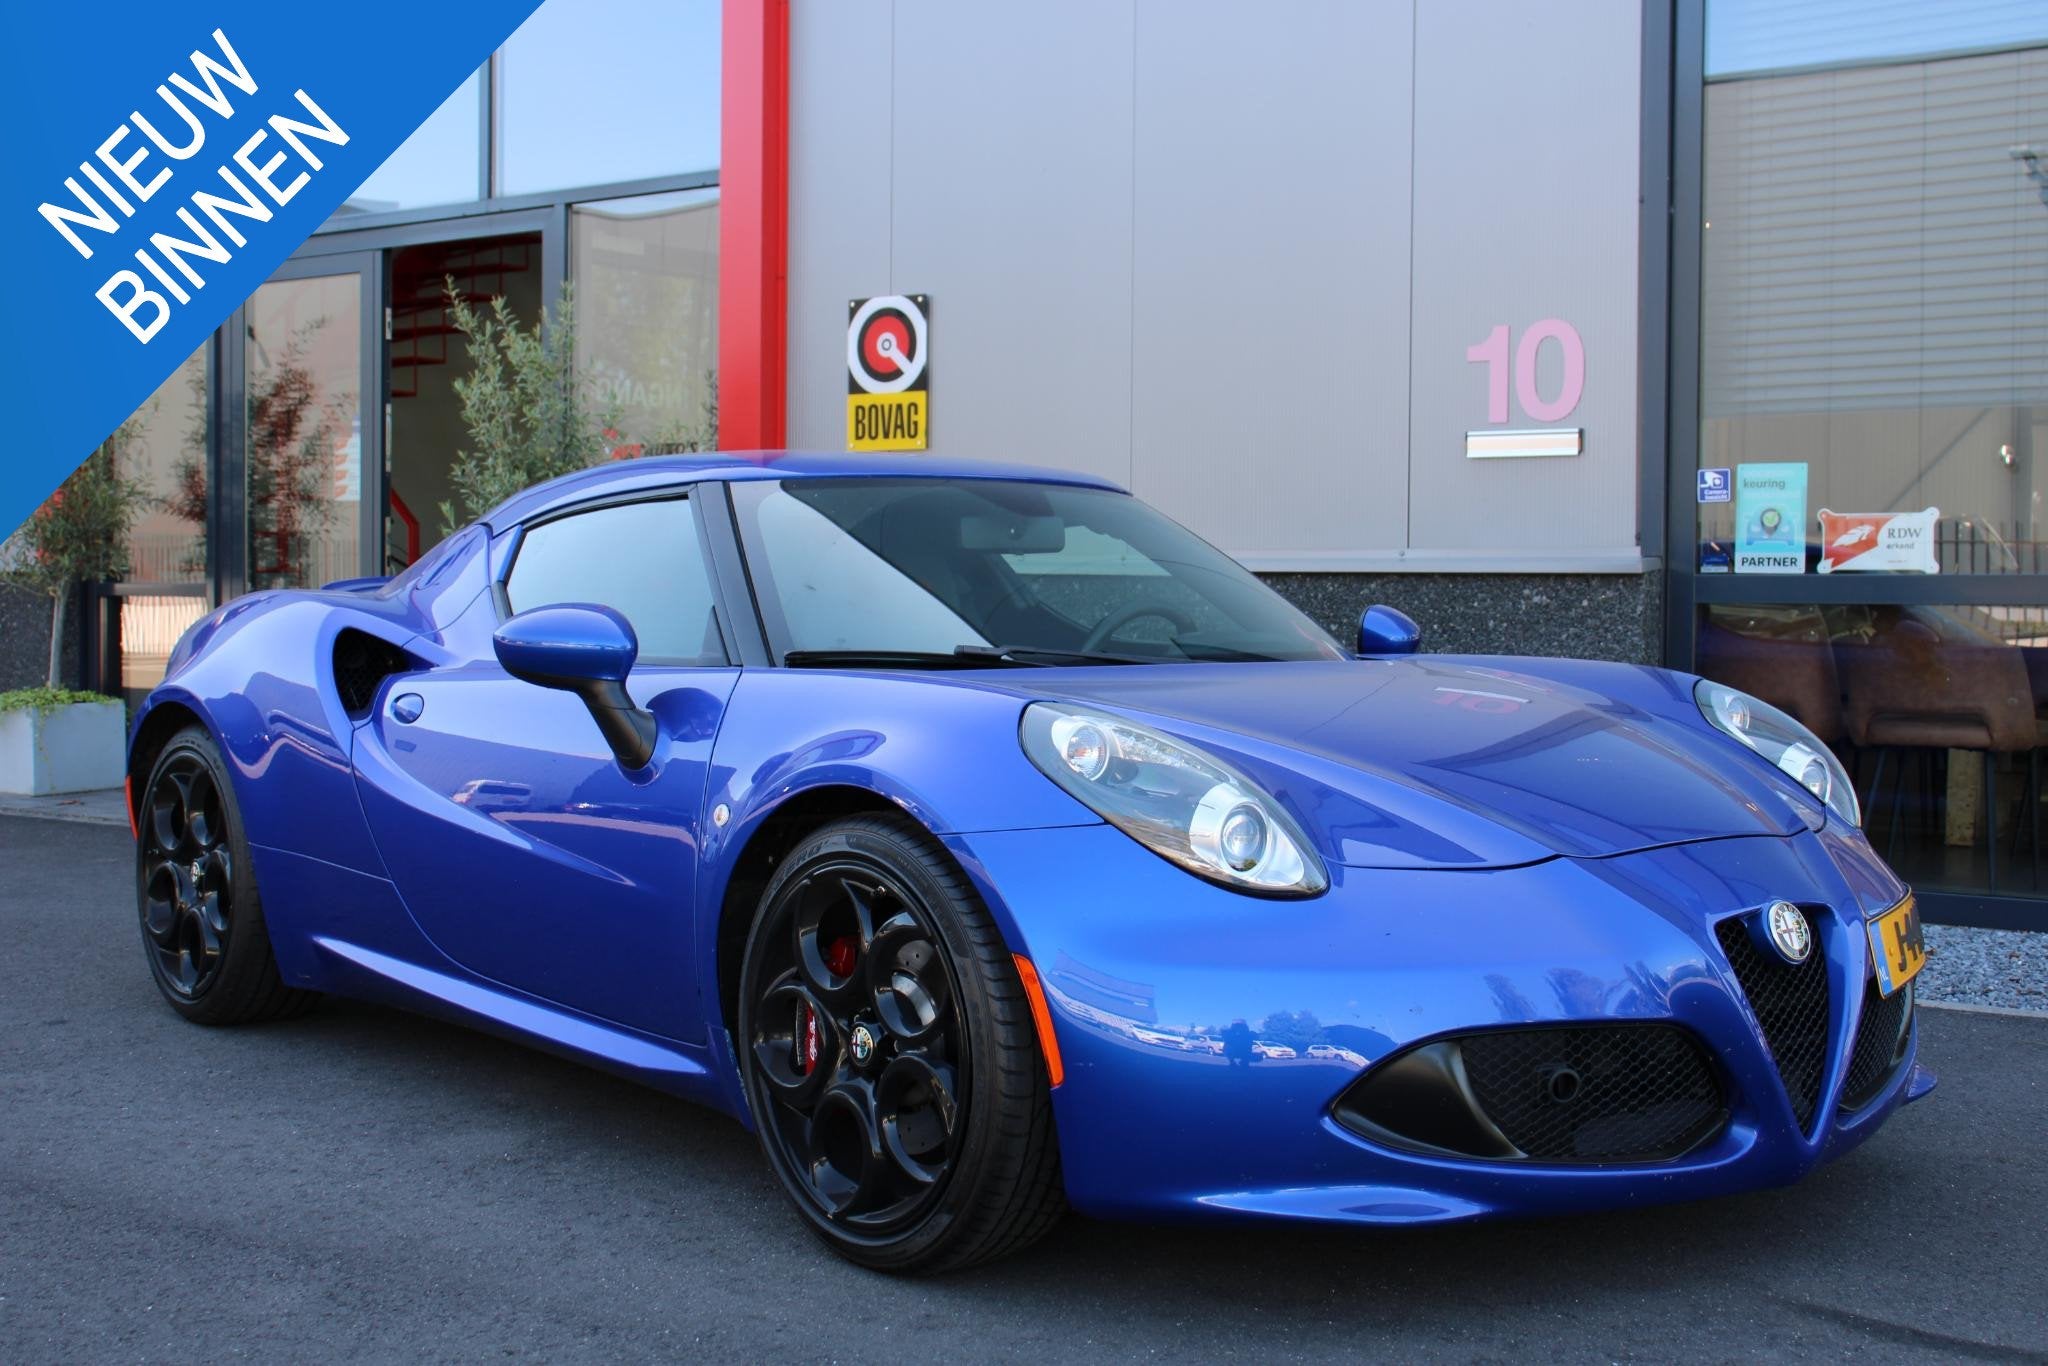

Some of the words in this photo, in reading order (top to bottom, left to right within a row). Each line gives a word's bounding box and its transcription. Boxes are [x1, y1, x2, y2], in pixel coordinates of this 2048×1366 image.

[1466, 316, 1586, 425] 10
[855, 402, 919, 441] BOVAG
[1743, 478, 1786, 490] keuring
[1887, 527, 1922, 539] RDW
[1741, 556, 1798, 568] PARTNER
